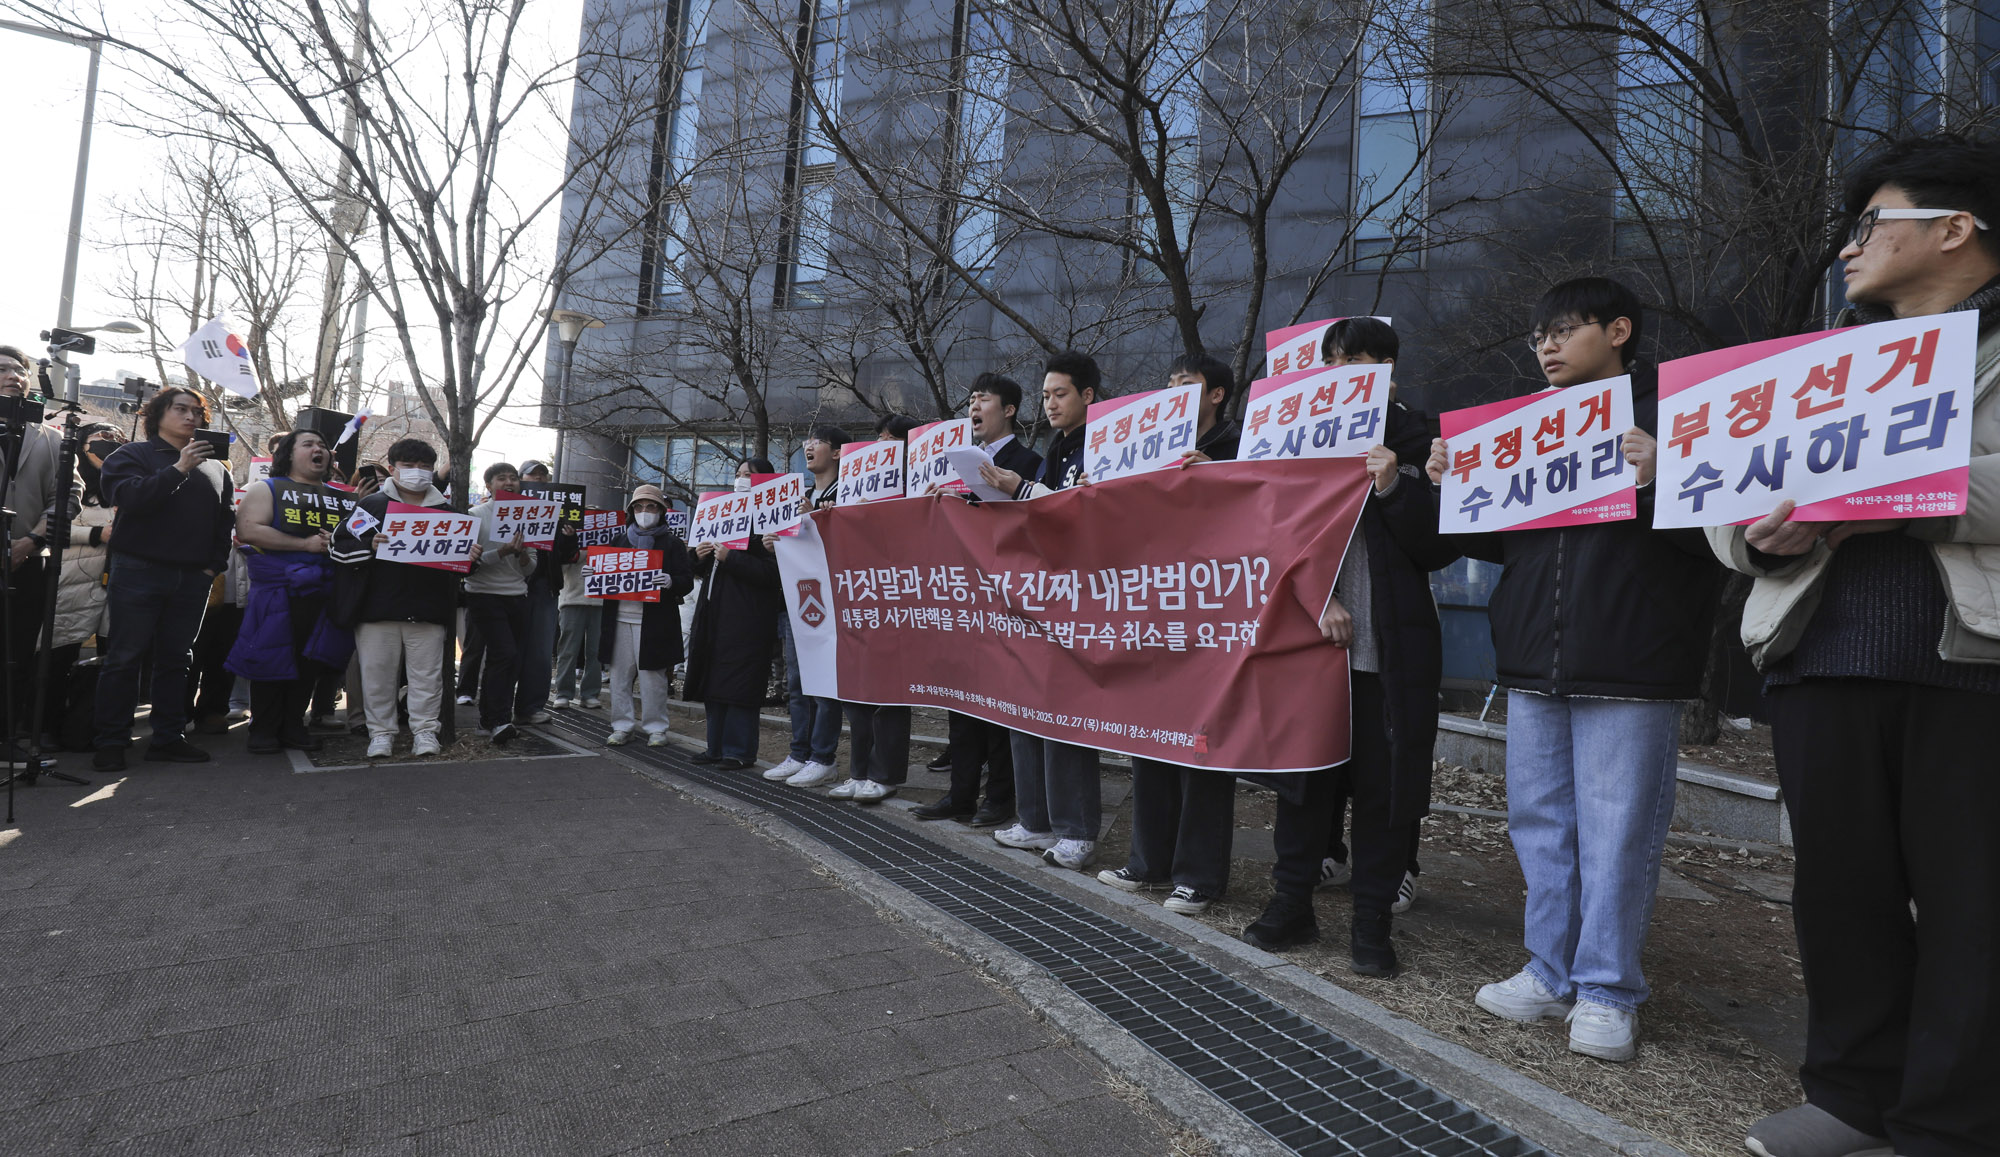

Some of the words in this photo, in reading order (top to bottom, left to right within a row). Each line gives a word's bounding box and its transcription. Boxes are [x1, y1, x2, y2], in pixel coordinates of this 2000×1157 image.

[1271, 340, 1316, 377] 부정
[1248, 372, 1376, 436] 부정선거
[1668, 328, 1941, 459] 부정선거
[1089, 392, 1189, 455] 부정선거
[1247, 407, 1380, 459] 수사하라
[1451, 388, 1612, 484] 부정선거
[840, 446, 897, 482] 부정선거
[909, 424, 964, 470] 부정선거
[1092, 420, 1193, 481] 수사하라
[1678, 390, 1959, 513] 수사하라
[841, 468, 900, 503] 수사하라
[911, 457, 951, 492] 수사하
[1459, 433, 1625, 523] 수사하라
[695, 497, 749, 524] 부정선거
[754, 478, 800, 509] 부정선거
[1845, 494, 1914, 505] 자유민주주의를
[1916, 492, 1959, 502] 수호하는
[1893, 504, 1914, 513] 애국
[1915, 501, 1958, 512] 서강인들
[284, 508, 340, 529] 원천무
[387, 520, 474, 537] 부정선거
[496, 505, 556, 521] 부정선거
[497, 522, 556, 538] 수사하라
[584, 511, 618, 530] 통령을
[695, 515, 750, 542] 수사하라
[388, 539, 474, 557] 수사하라
[588, 550, 649, 573] 대통령을
[587, 570, 660, 596] 석방하라
[835, 566, 923, 602] 거짓말과
[927, 565, 976, 605] 선동,
[1017, 569, 1083, 612] 진짜
[1088, 556, 1270, 612] 내란범인가?
[842, 608, 880, 629] 대통령
[884, 607, 954, 632] 사기탄핵을
[957, 609, 984, 633] 즉시
[987, 612, 1042, 639] 각하하고
[1121, 621, 1188, 652] 취소를
[1022, 706, 1036, 720] 일시:
[1036, 711, 1055, 725] 2025.
[1056, 714, 1069, 727] 02.
[1071, 717, 1082, 728] 27
[1083, 717, 1099, 732] (목)
[1100, 721, 1122, 734] 14:00
[1128, 725, 1149, 739] 장소:
